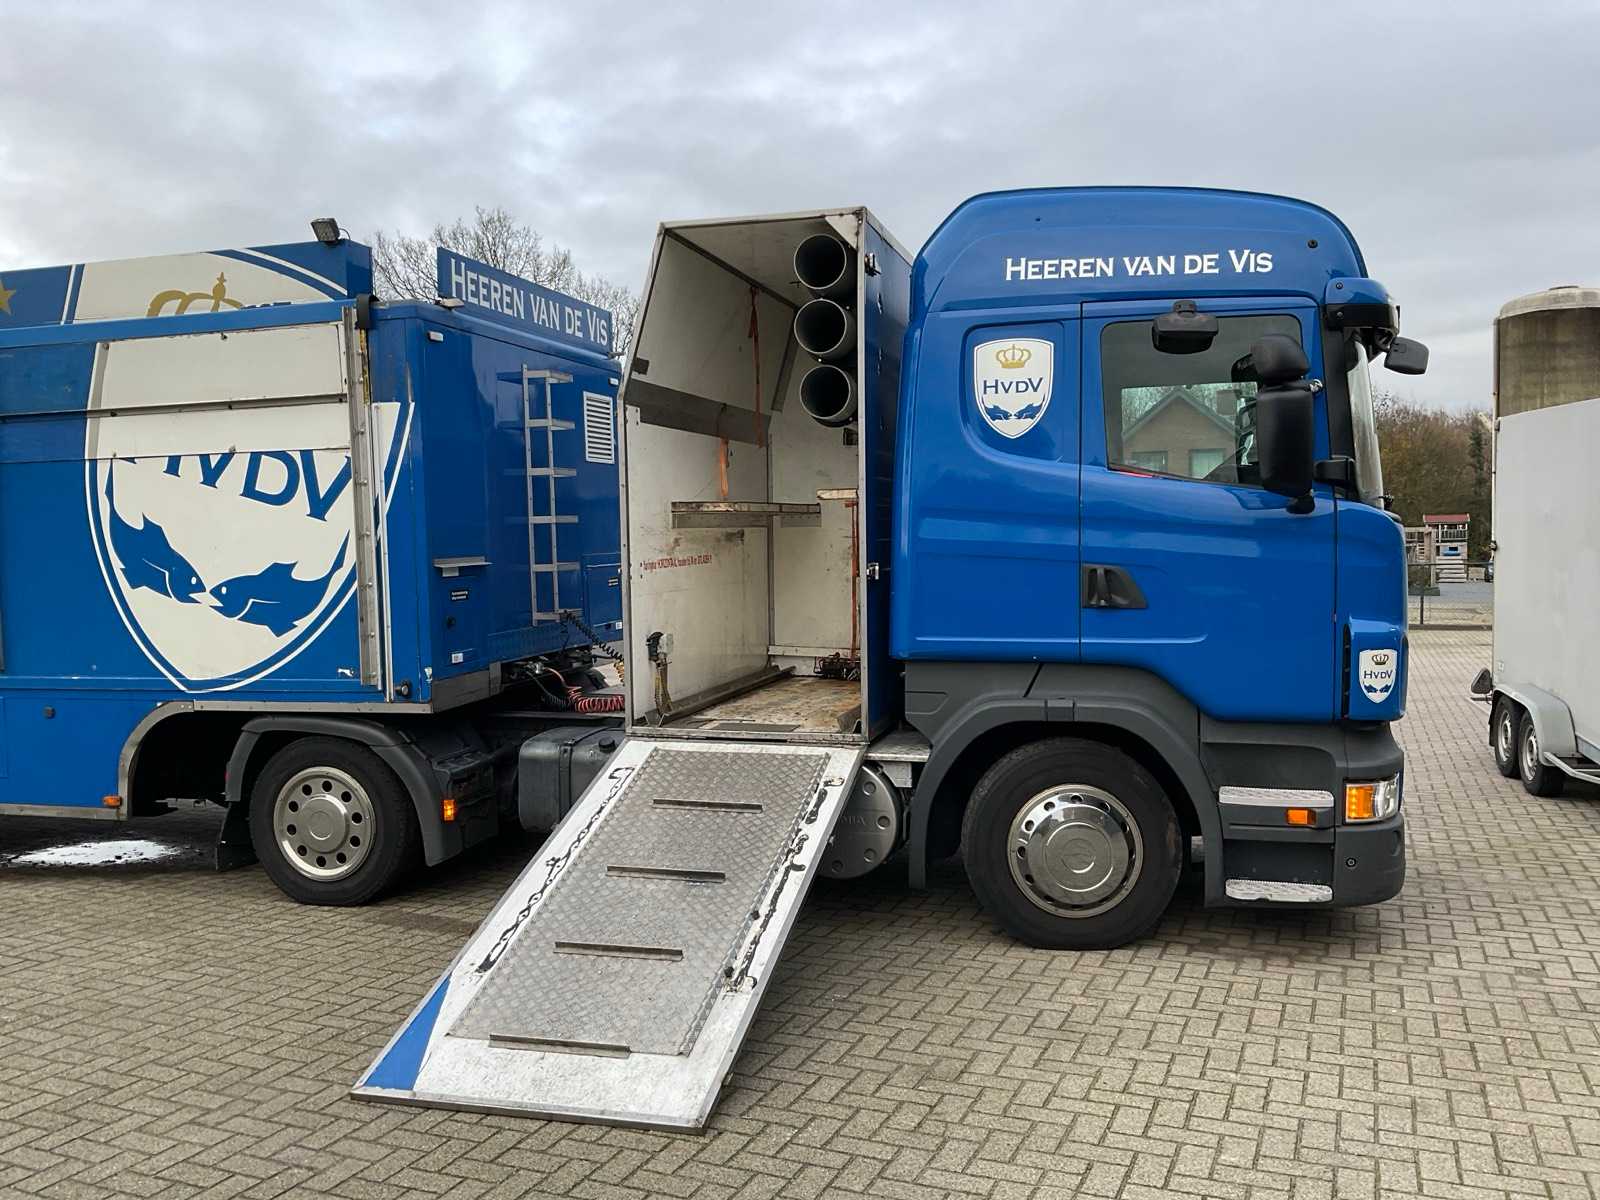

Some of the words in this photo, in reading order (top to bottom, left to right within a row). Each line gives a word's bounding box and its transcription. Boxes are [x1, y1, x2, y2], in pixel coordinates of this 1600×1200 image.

[1005, 257, 1114, 281] HEEREN
[1123, 255, 1175, 276] VAN
[1183, 253, 1219, 275] DE
[1228, 249, 1273, 273] VIS
[450, 258, 525, 320] HEEREN
[530, 294, 560, 331] VAN
[565, 306, 583, 338] DE
[586, 308, 608, 346] VIS
